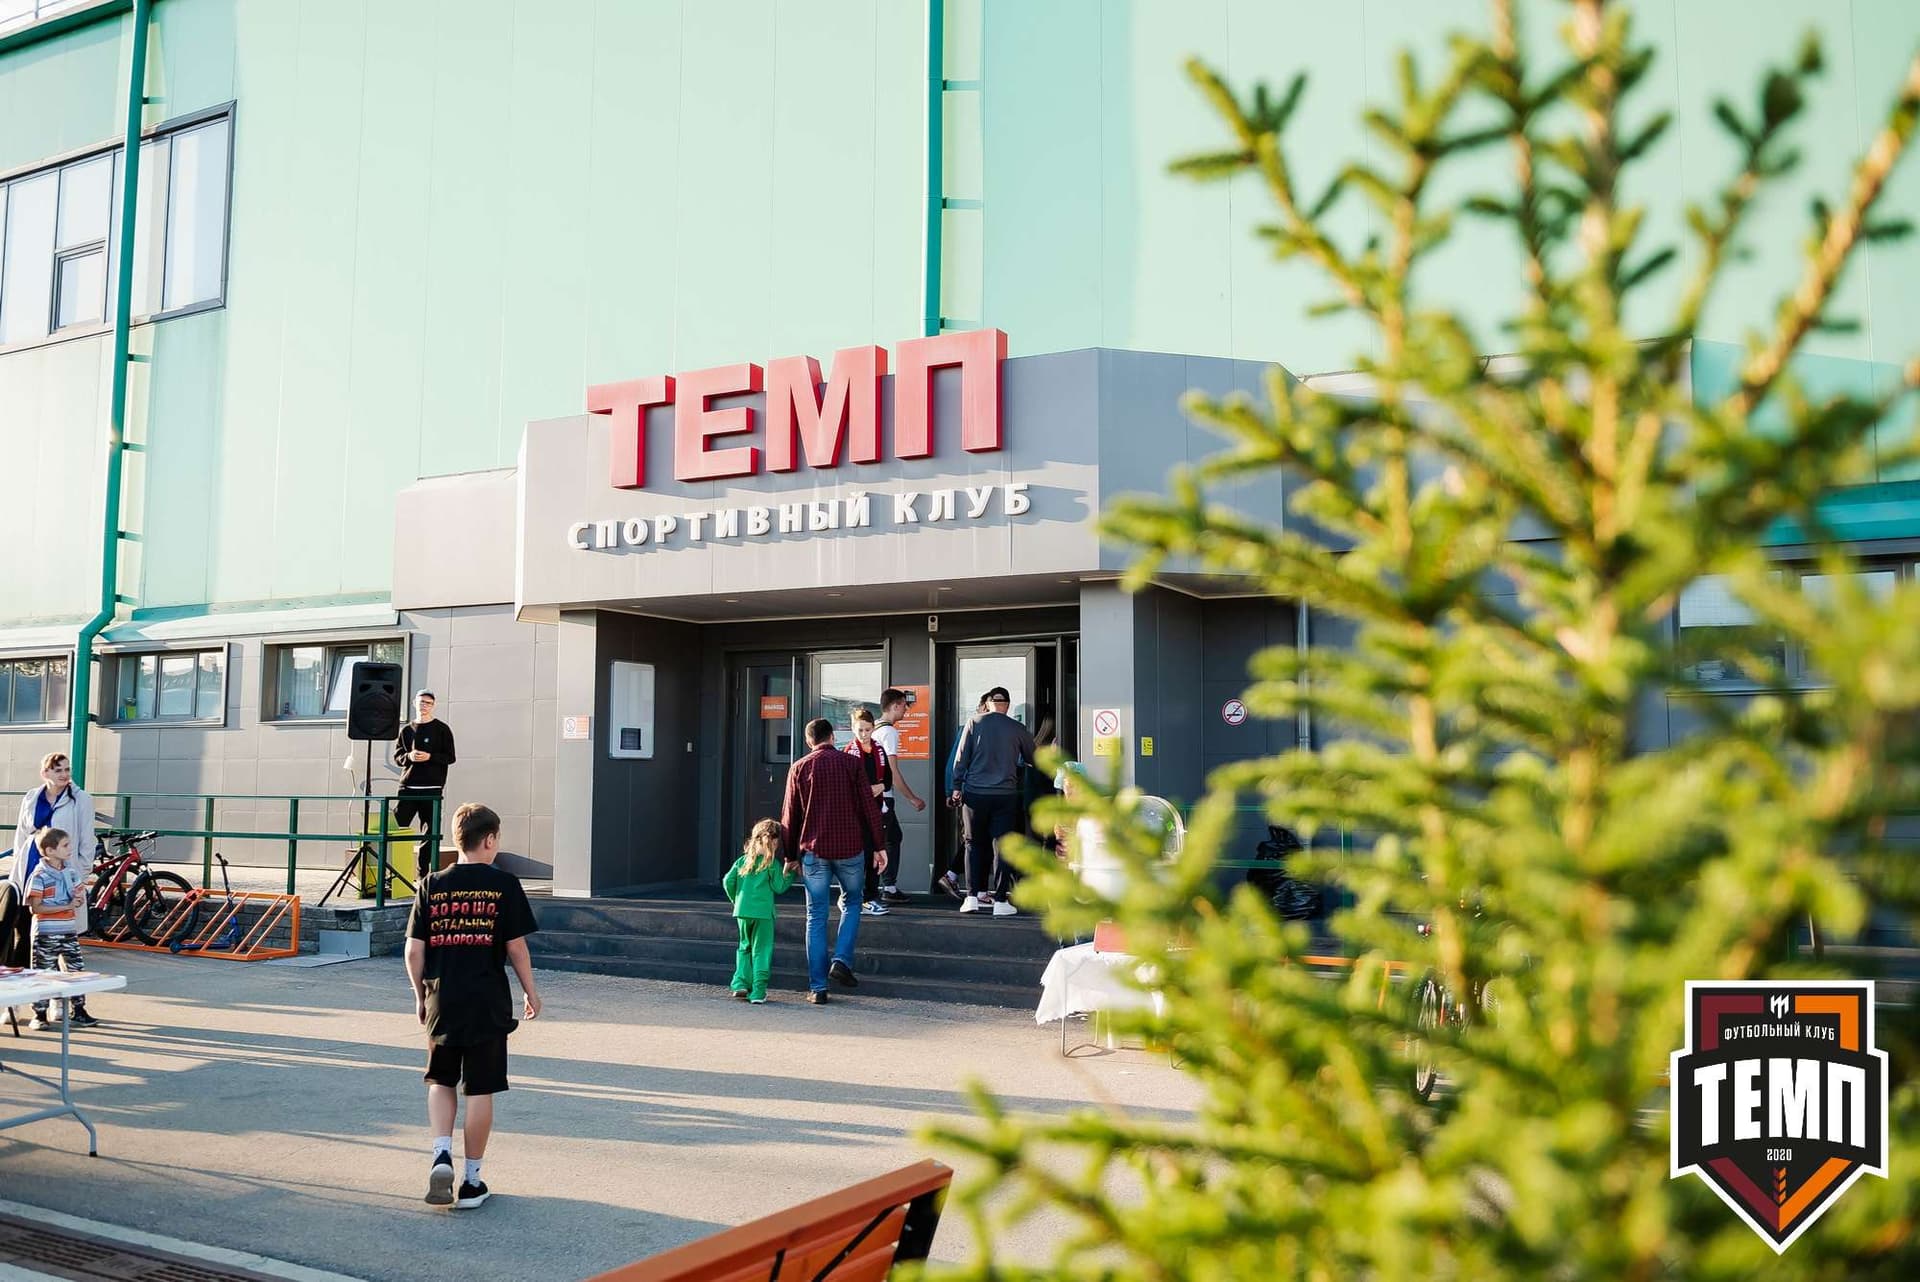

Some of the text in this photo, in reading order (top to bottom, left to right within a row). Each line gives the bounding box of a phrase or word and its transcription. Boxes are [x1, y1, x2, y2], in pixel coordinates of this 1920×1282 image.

[588, 328, 1008, 489] ТЕМП
[567, 483, 1031, 550] СПОРТИВНЫЙ КЛУБ
